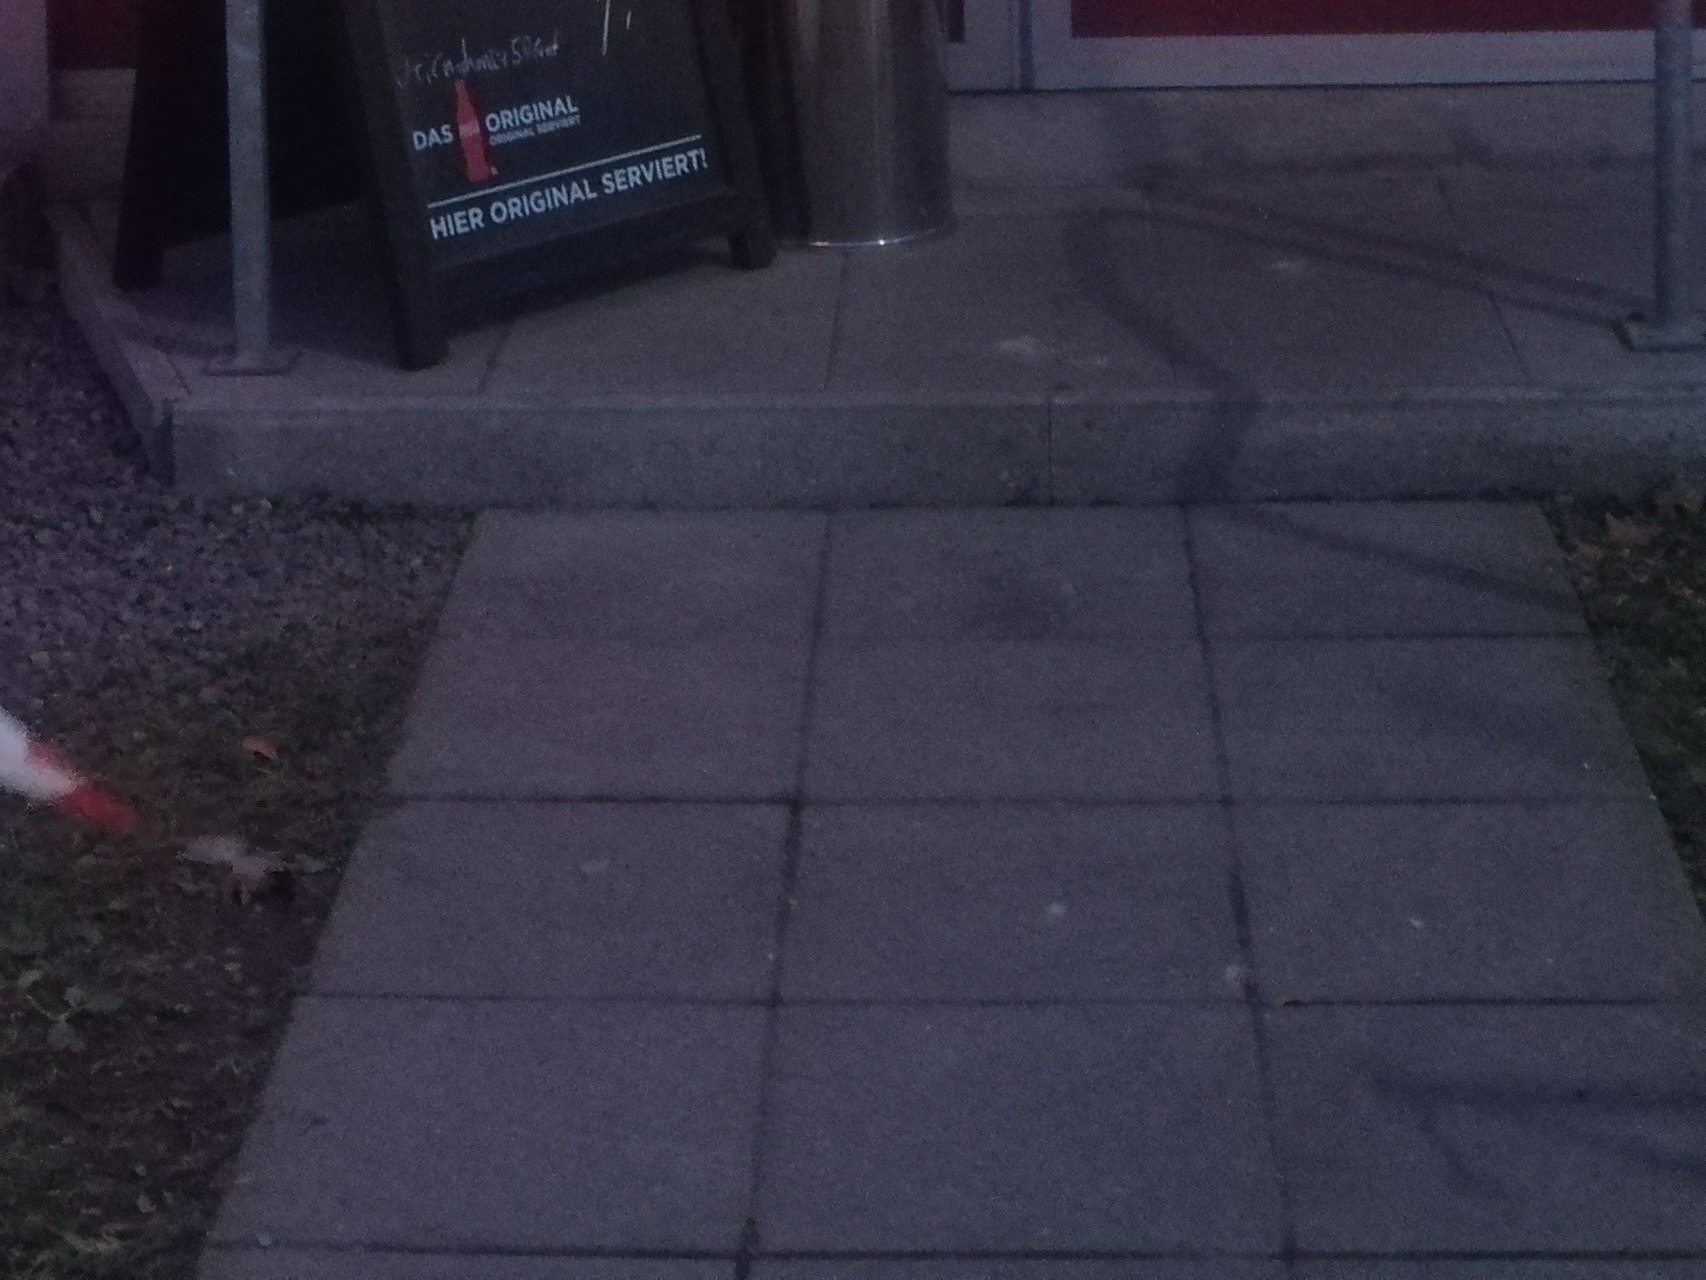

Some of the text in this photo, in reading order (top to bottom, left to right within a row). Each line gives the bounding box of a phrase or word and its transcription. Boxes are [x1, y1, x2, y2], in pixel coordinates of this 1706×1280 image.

[411, 122, 455, 153] DAS
[485, 94, 581, 133] ORIGINAL
[429, 146, 710, 241] HIER ORIGINAL SERVIERT!
